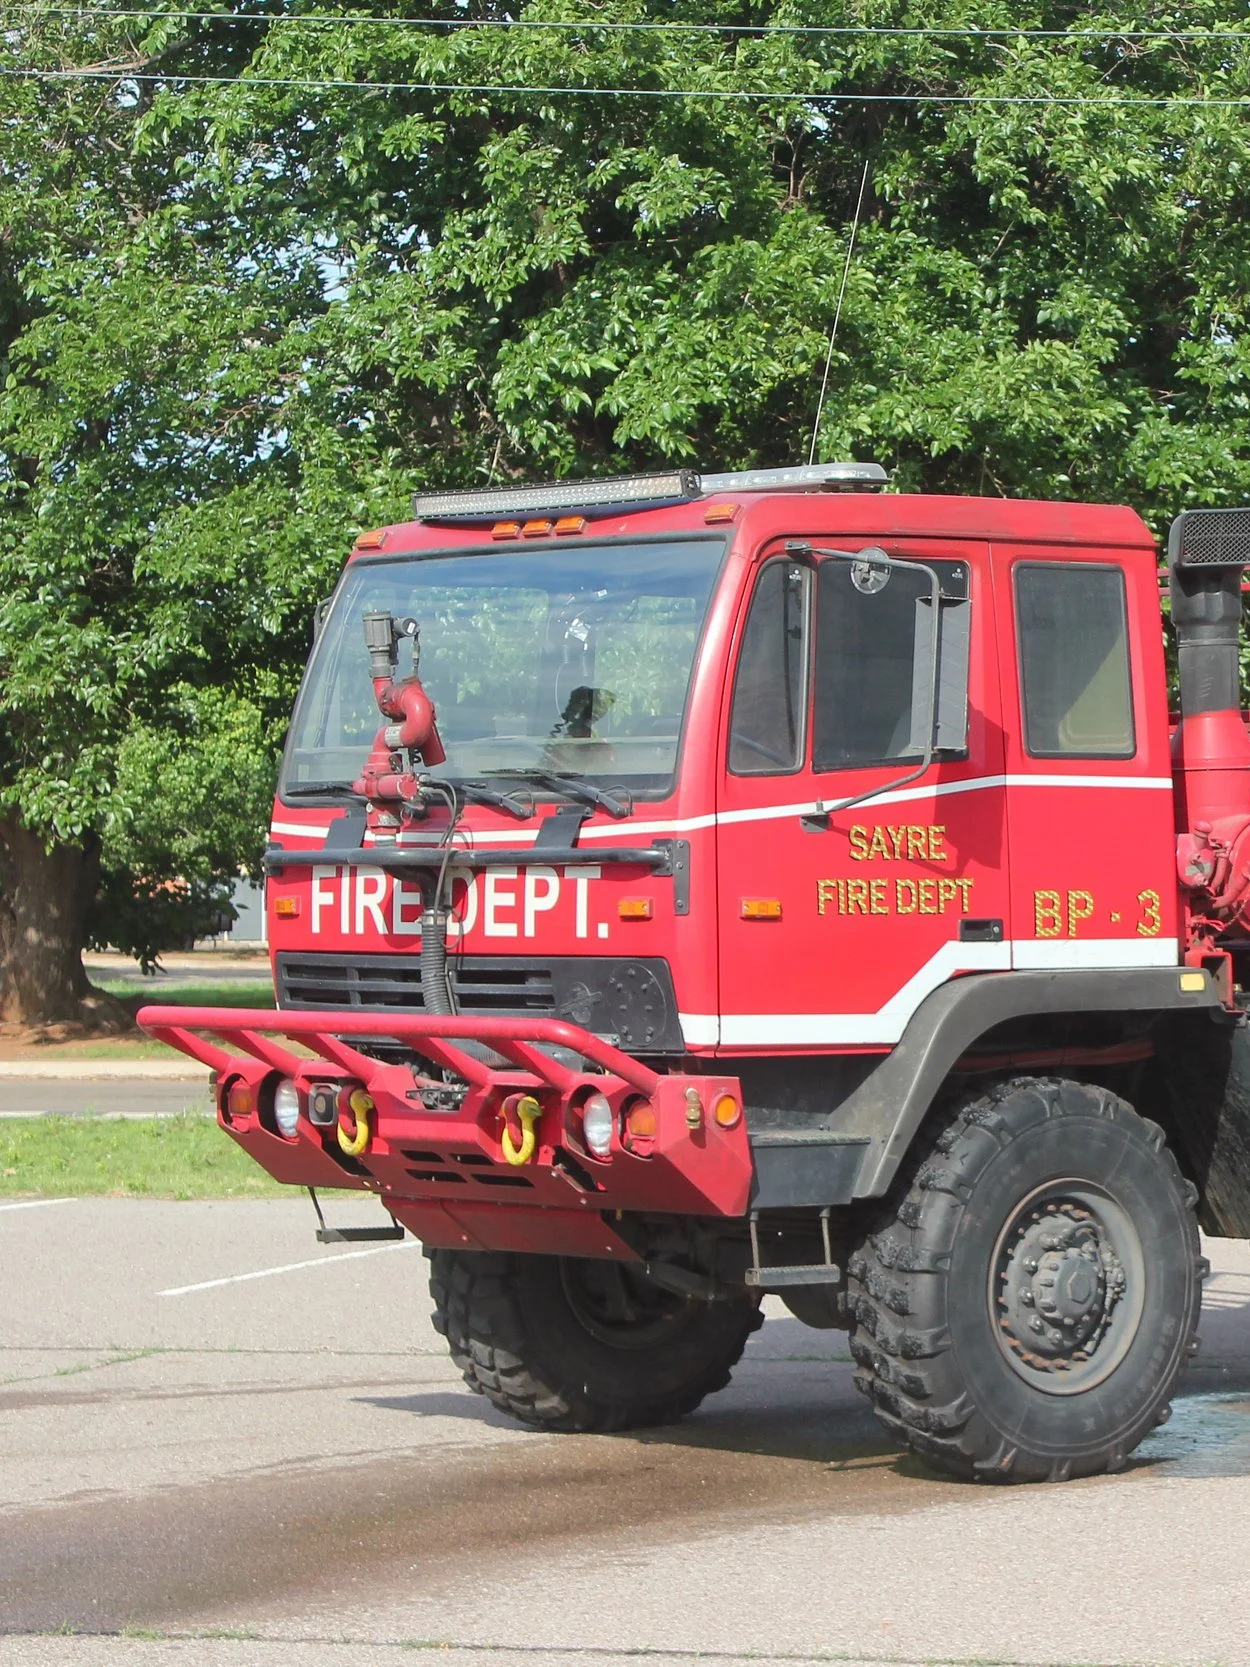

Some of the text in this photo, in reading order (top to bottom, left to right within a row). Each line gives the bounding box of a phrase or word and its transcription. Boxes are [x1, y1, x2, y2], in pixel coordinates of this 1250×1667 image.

[848, 824, 947, 861] SAYRE
[311, 864, 609, 939] FIRE DEPT.
[816, 877, 974, 915] FIRE DEPT
[1135, 888, 1161, 936] 3
